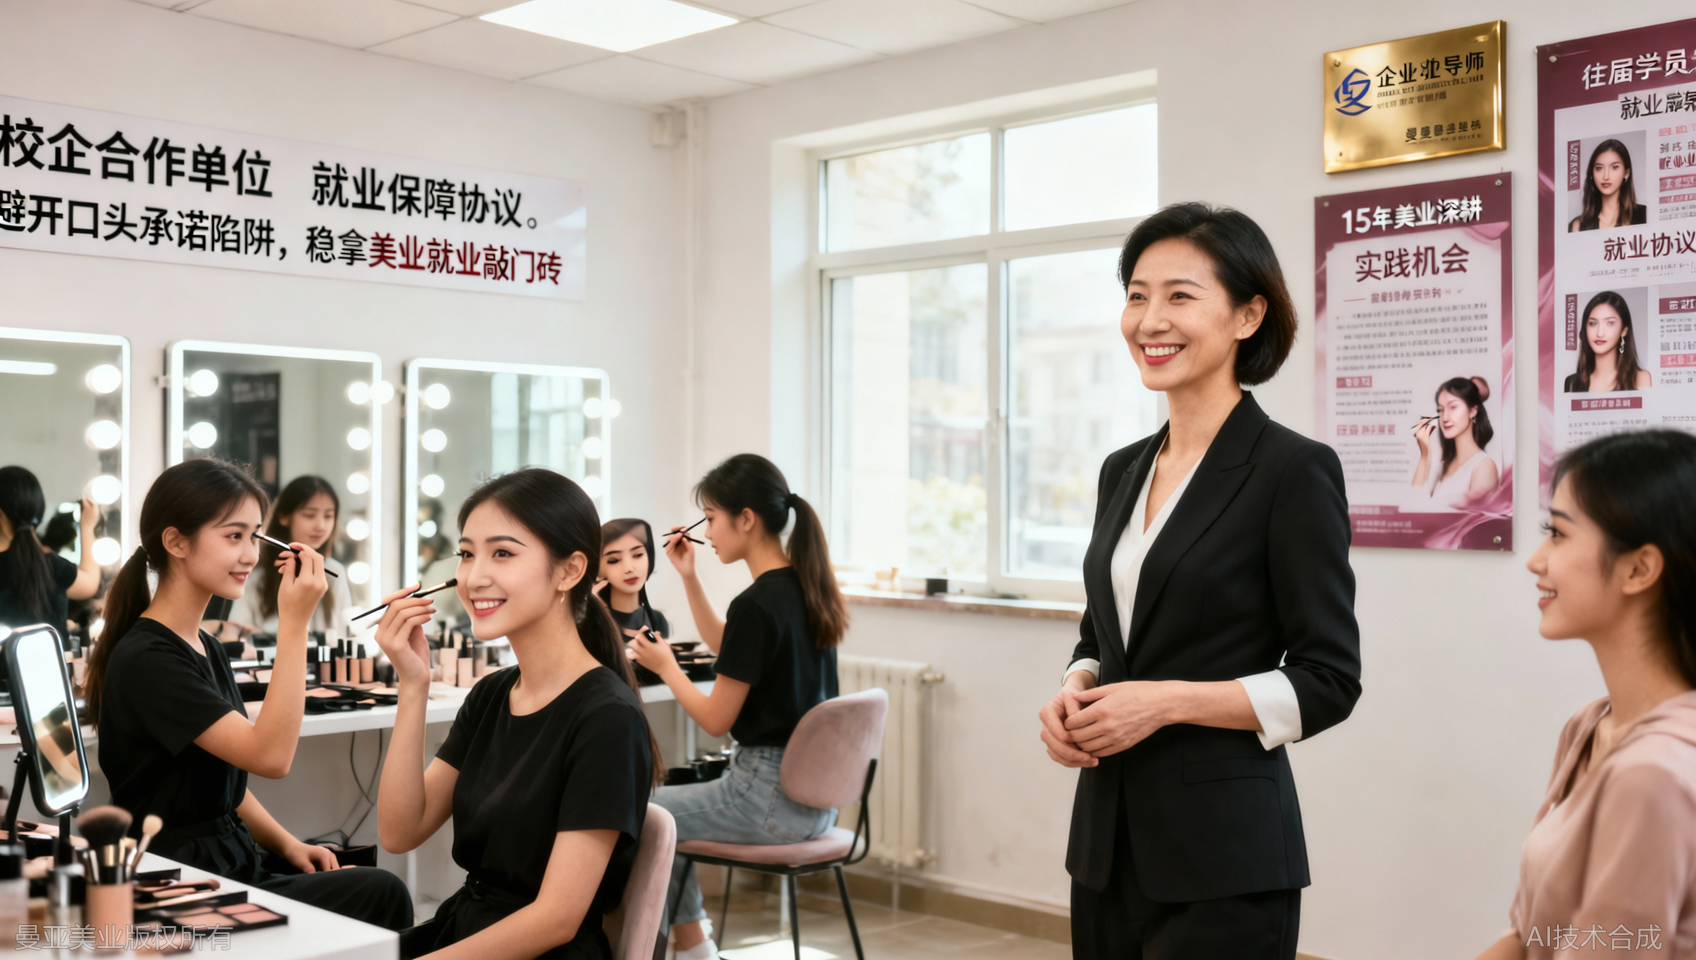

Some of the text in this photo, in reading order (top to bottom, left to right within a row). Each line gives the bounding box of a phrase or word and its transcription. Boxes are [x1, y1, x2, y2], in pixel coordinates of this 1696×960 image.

[1582, 48, 1696, 90] 往届学员
[0, 114, 537, 230] 校企合作单位 就业保障协议。
[1355, 242, 1470, 282] 实践机会
[1603, 230, 1696, 261] 就业协议
